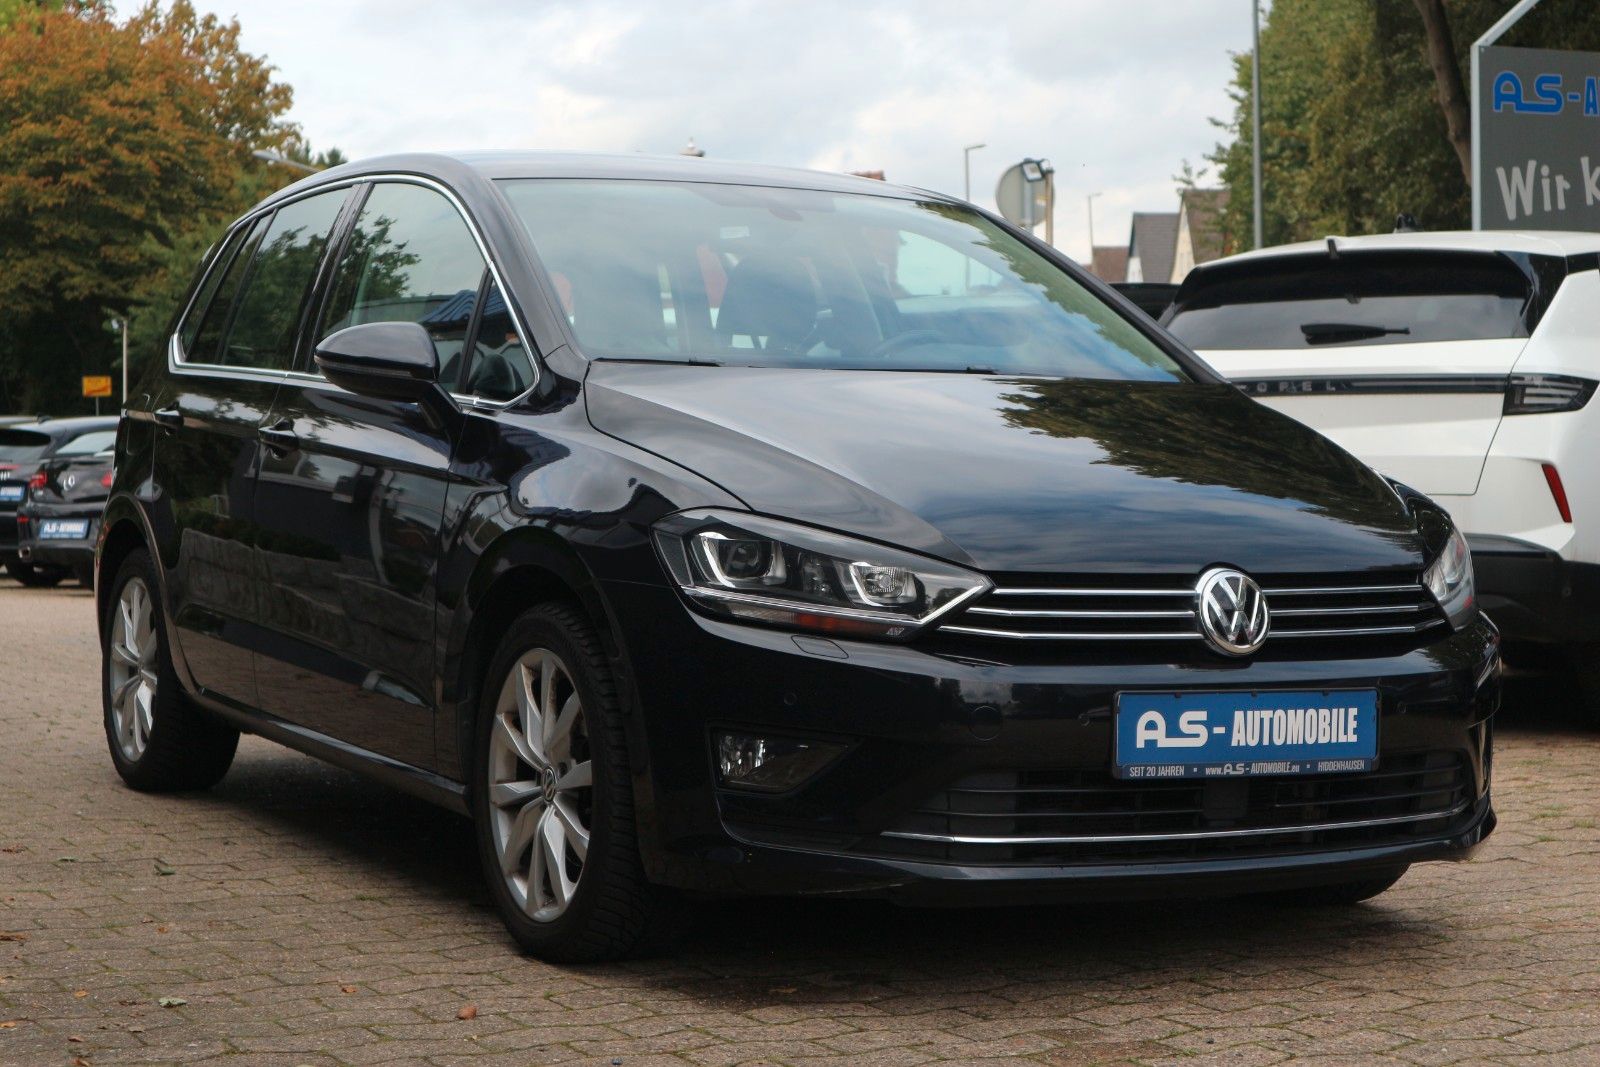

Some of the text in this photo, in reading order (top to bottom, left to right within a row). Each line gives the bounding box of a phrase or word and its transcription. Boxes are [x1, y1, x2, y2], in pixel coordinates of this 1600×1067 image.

[1493, 70, 1600, 116] AS-A
[1496, 159, 1571, 221] Wir
[1256, 380, 1336, 393] OPEL
[1129, 766, 1145, 777] SEIT
[1146, 766, 1156, 777] 20
[1157, 765, 1185, 777] JAHREN
[1317, 760, 1365, 772] HIDDENHAUSEN
